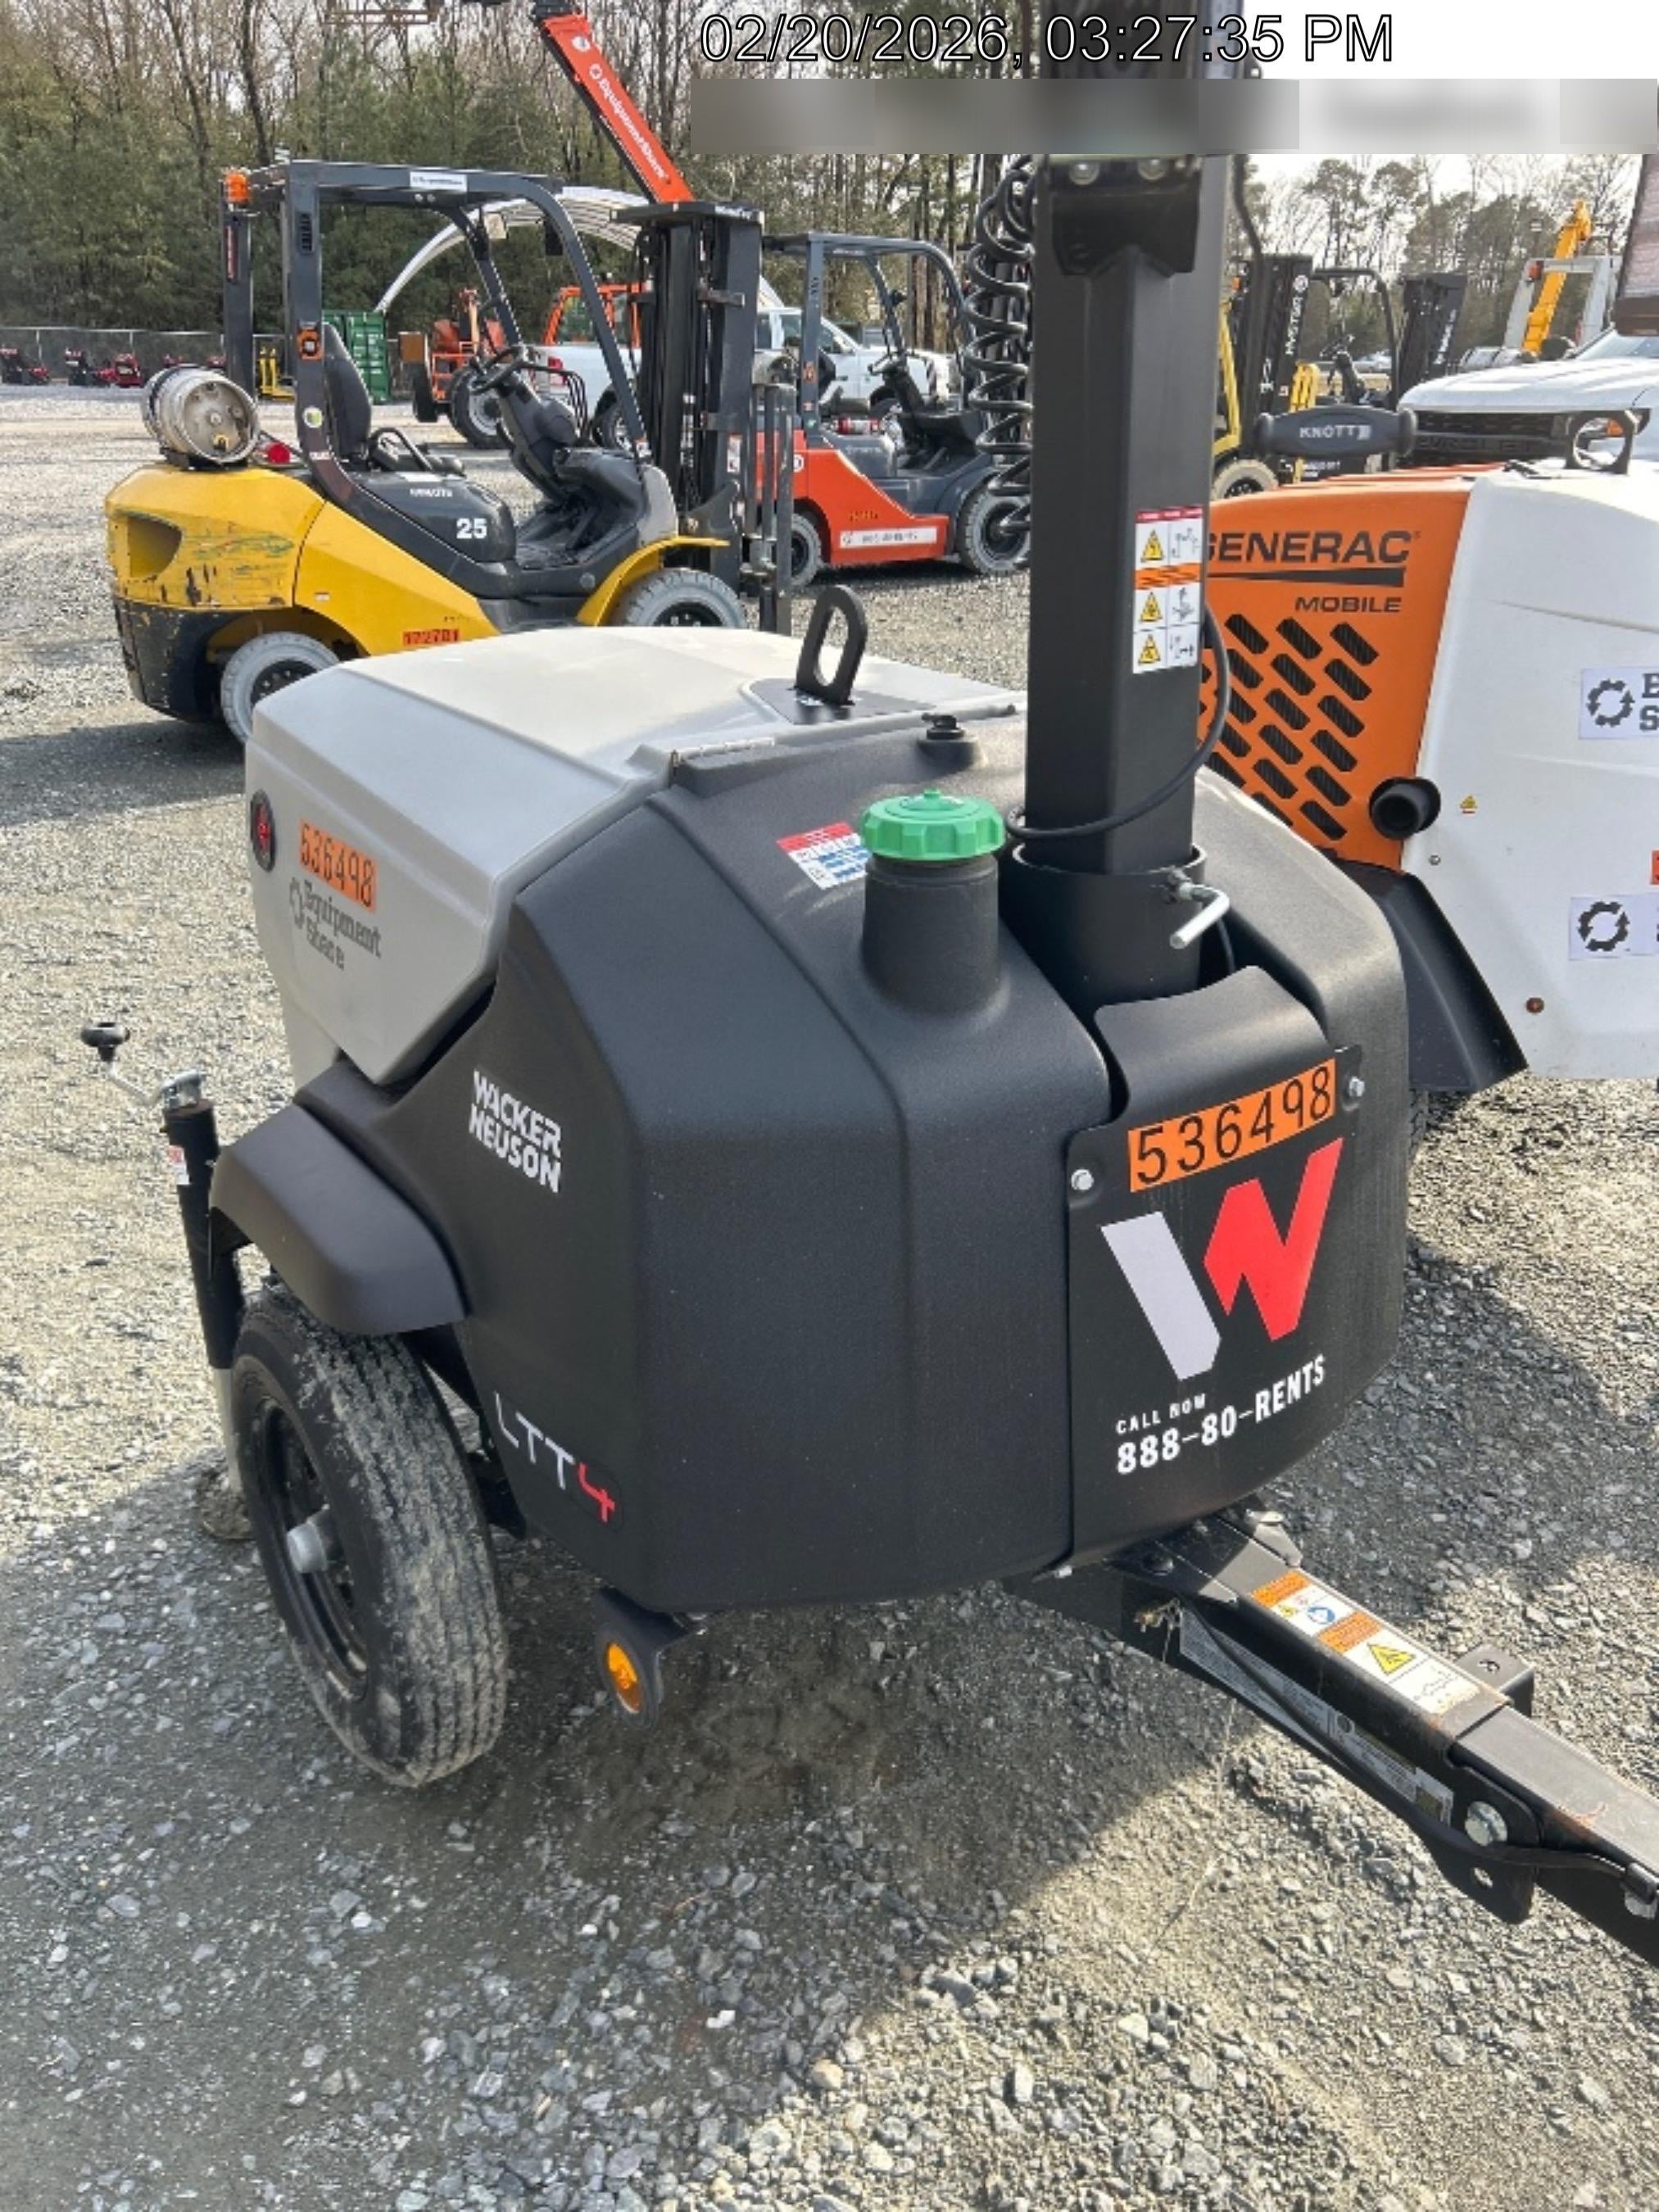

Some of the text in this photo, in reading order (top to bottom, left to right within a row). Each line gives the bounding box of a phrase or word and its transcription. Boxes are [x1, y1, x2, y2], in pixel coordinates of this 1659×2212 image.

[1299, 424, 1358, 438] KNOTT
[456, 517, 487, 540] 25
[1294, 596, 1402, 613] MOBILE
[300, 822, 374, 908] 536498
[468, 1102, 562, 1194] NEUSON
[473, 1068, 562, 1158] WACKER
[1135, 1066, 1332, 1185] 536498
[493, 1390, 615, 1523] LTT4
[1115, 1392, 1207, 1435] CALL NOW
[1117, 1354, 1326, 1475] 888-80-RENTS
